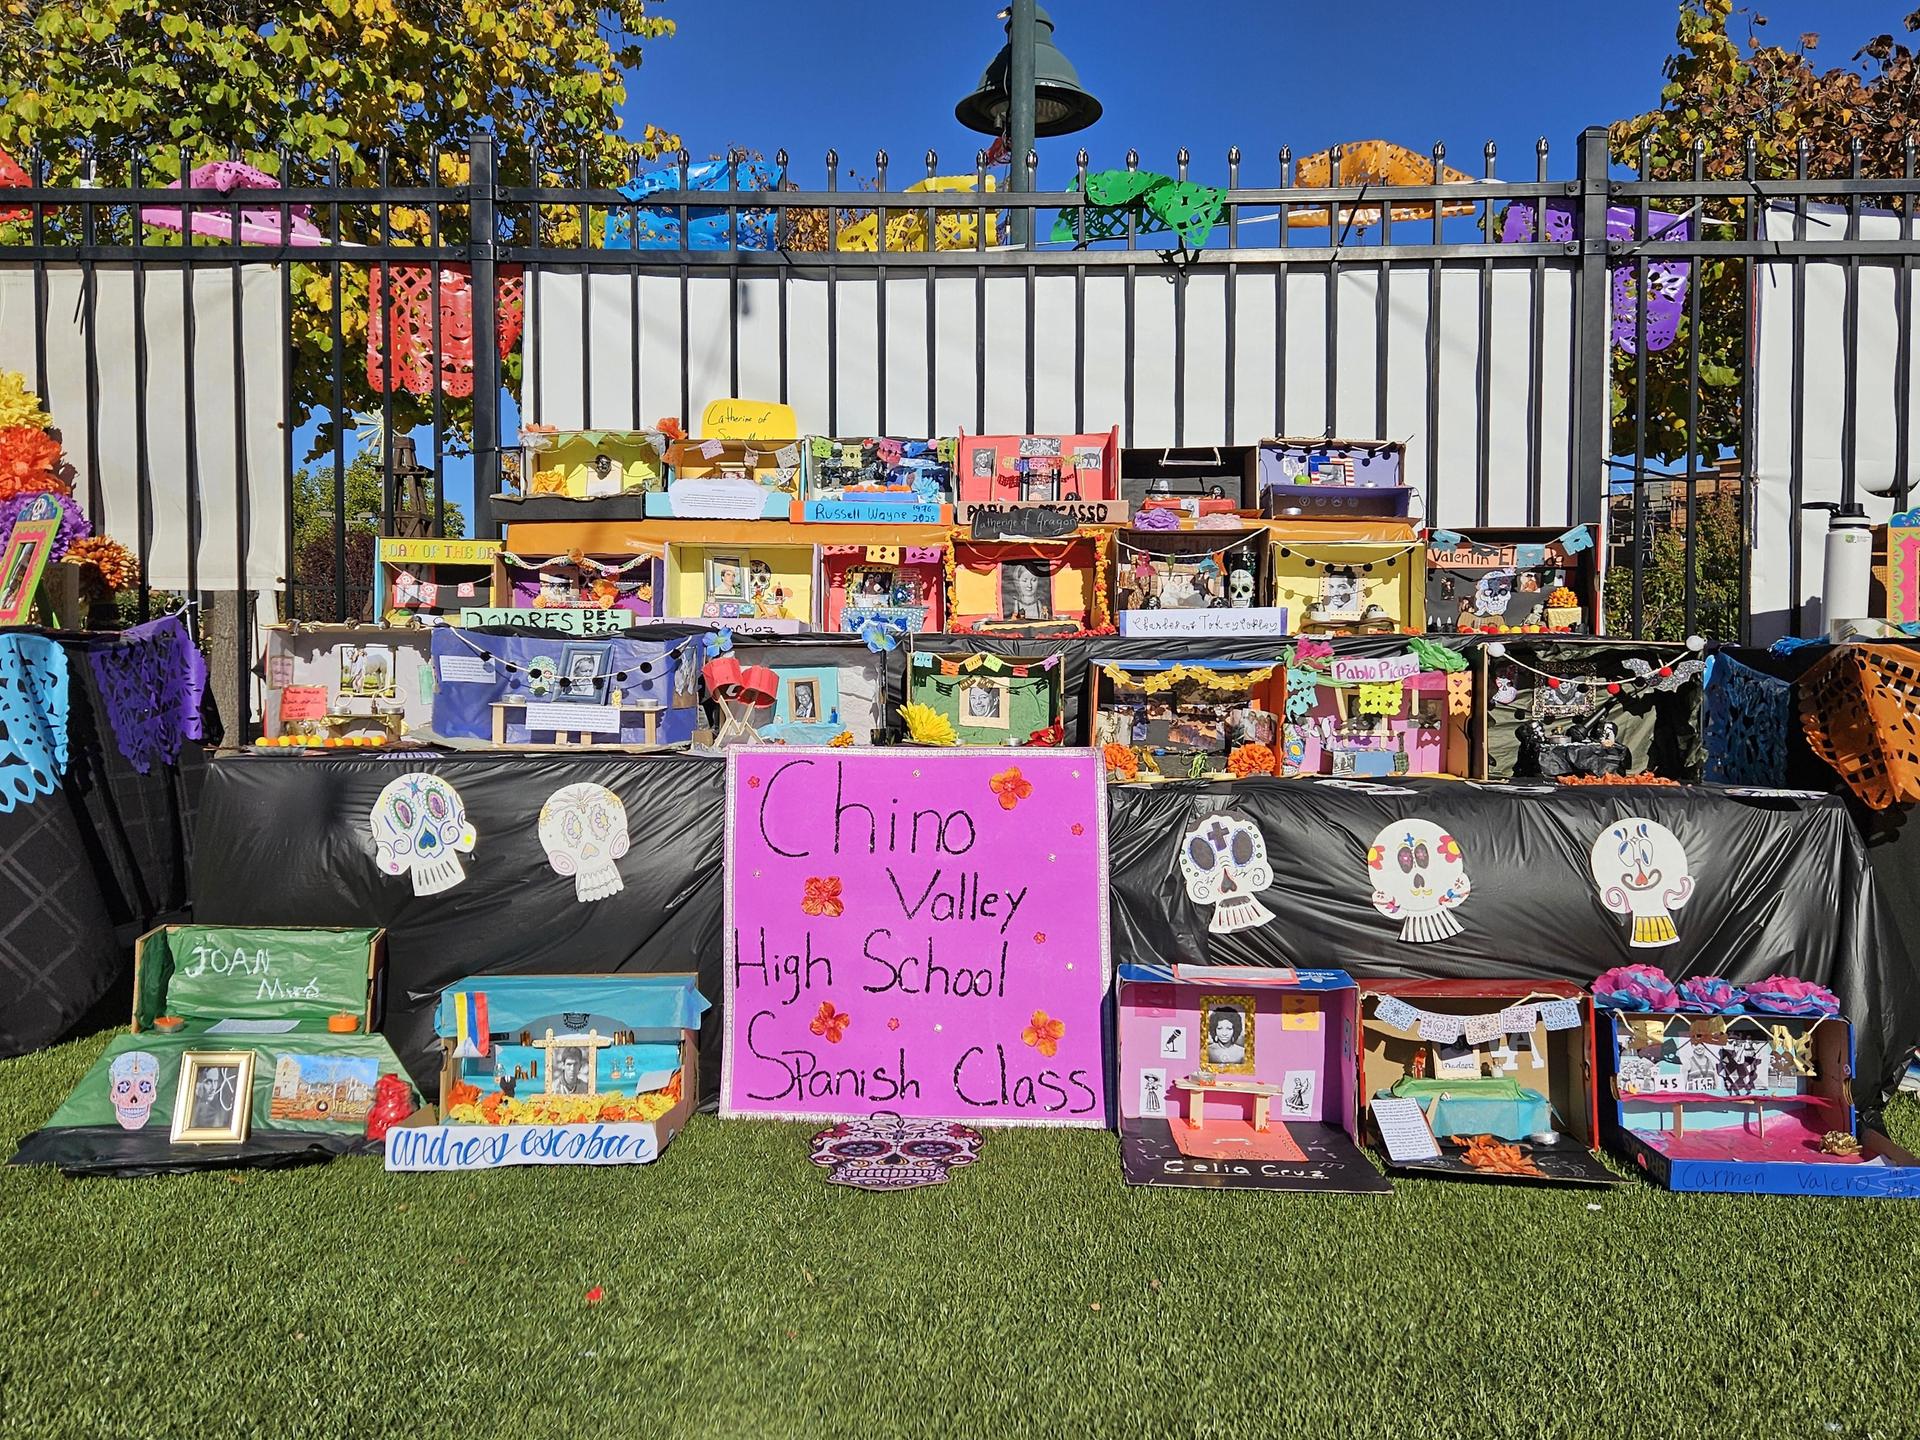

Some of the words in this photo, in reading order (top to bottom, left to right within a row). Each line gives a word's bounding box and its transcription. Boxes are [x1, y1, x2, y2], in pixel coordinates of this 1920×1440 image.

[707, 404, 752, 425] Catherine
[758, 411, 771, 424] of
[815, 503, 860, 520] Russell
[868, 508, 908, 524] Wayne
[912, 513, 936, 523] 2025
[975, 511, 1017, 538] Catherine
[1021, 509, 1032, 532] of
[1036, 512, 1079, 535] Aragon
[389, 543, 418, 558] DAY
[423, 544, 440, 558] OF
[444, 545, 474, 559] THE
[583, 610, 620, 620] DEL
[1336, 662, 1376, 680] Pablo
[760, 760, 976, 858] Chino
[886, 867, 1028, 935] Valley
[185, 945, 270, 978] JOAN
[735, 927, 833, 1006] High
[863, 929, 1009, 998] School
[952, 1043, 1097, 1114] Class
[520, 1125, 654, 1160] escobar
[1164, 1160, 1250, 1175] Celia
[1261, 1164, 1327, 1178] Cruz
[1682, 1164, 1765, 1188] Carmen
[1798, 1171, 1870, 1191] Valero
